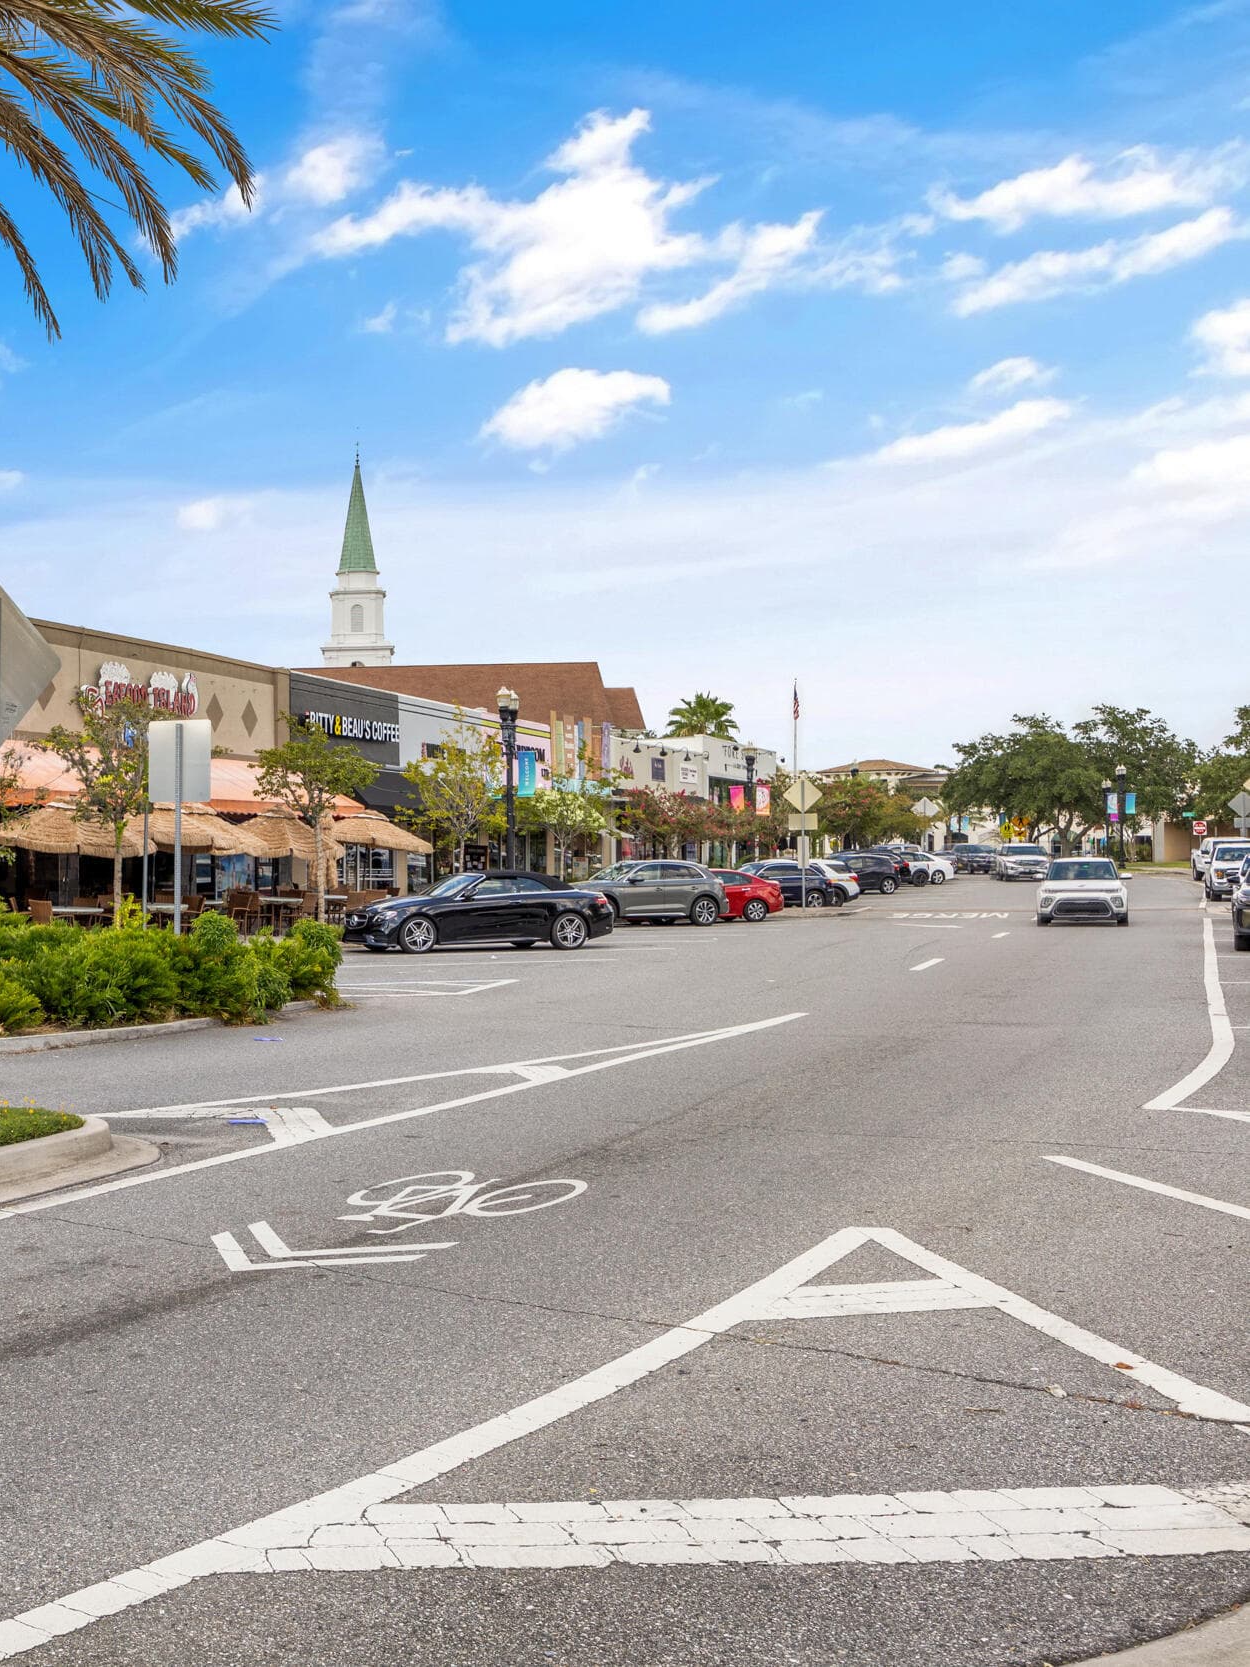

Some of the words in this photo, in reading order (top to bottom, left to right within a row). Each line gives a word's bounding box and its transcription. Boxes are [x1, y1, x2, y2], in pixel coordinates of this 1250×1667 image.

[152, 686, 197, 717] ISLAND
[334, 715, 342, 736] &
[342, 716, 371, 740] BEAU'S
[372, 721, 400, 742] COFFEE
